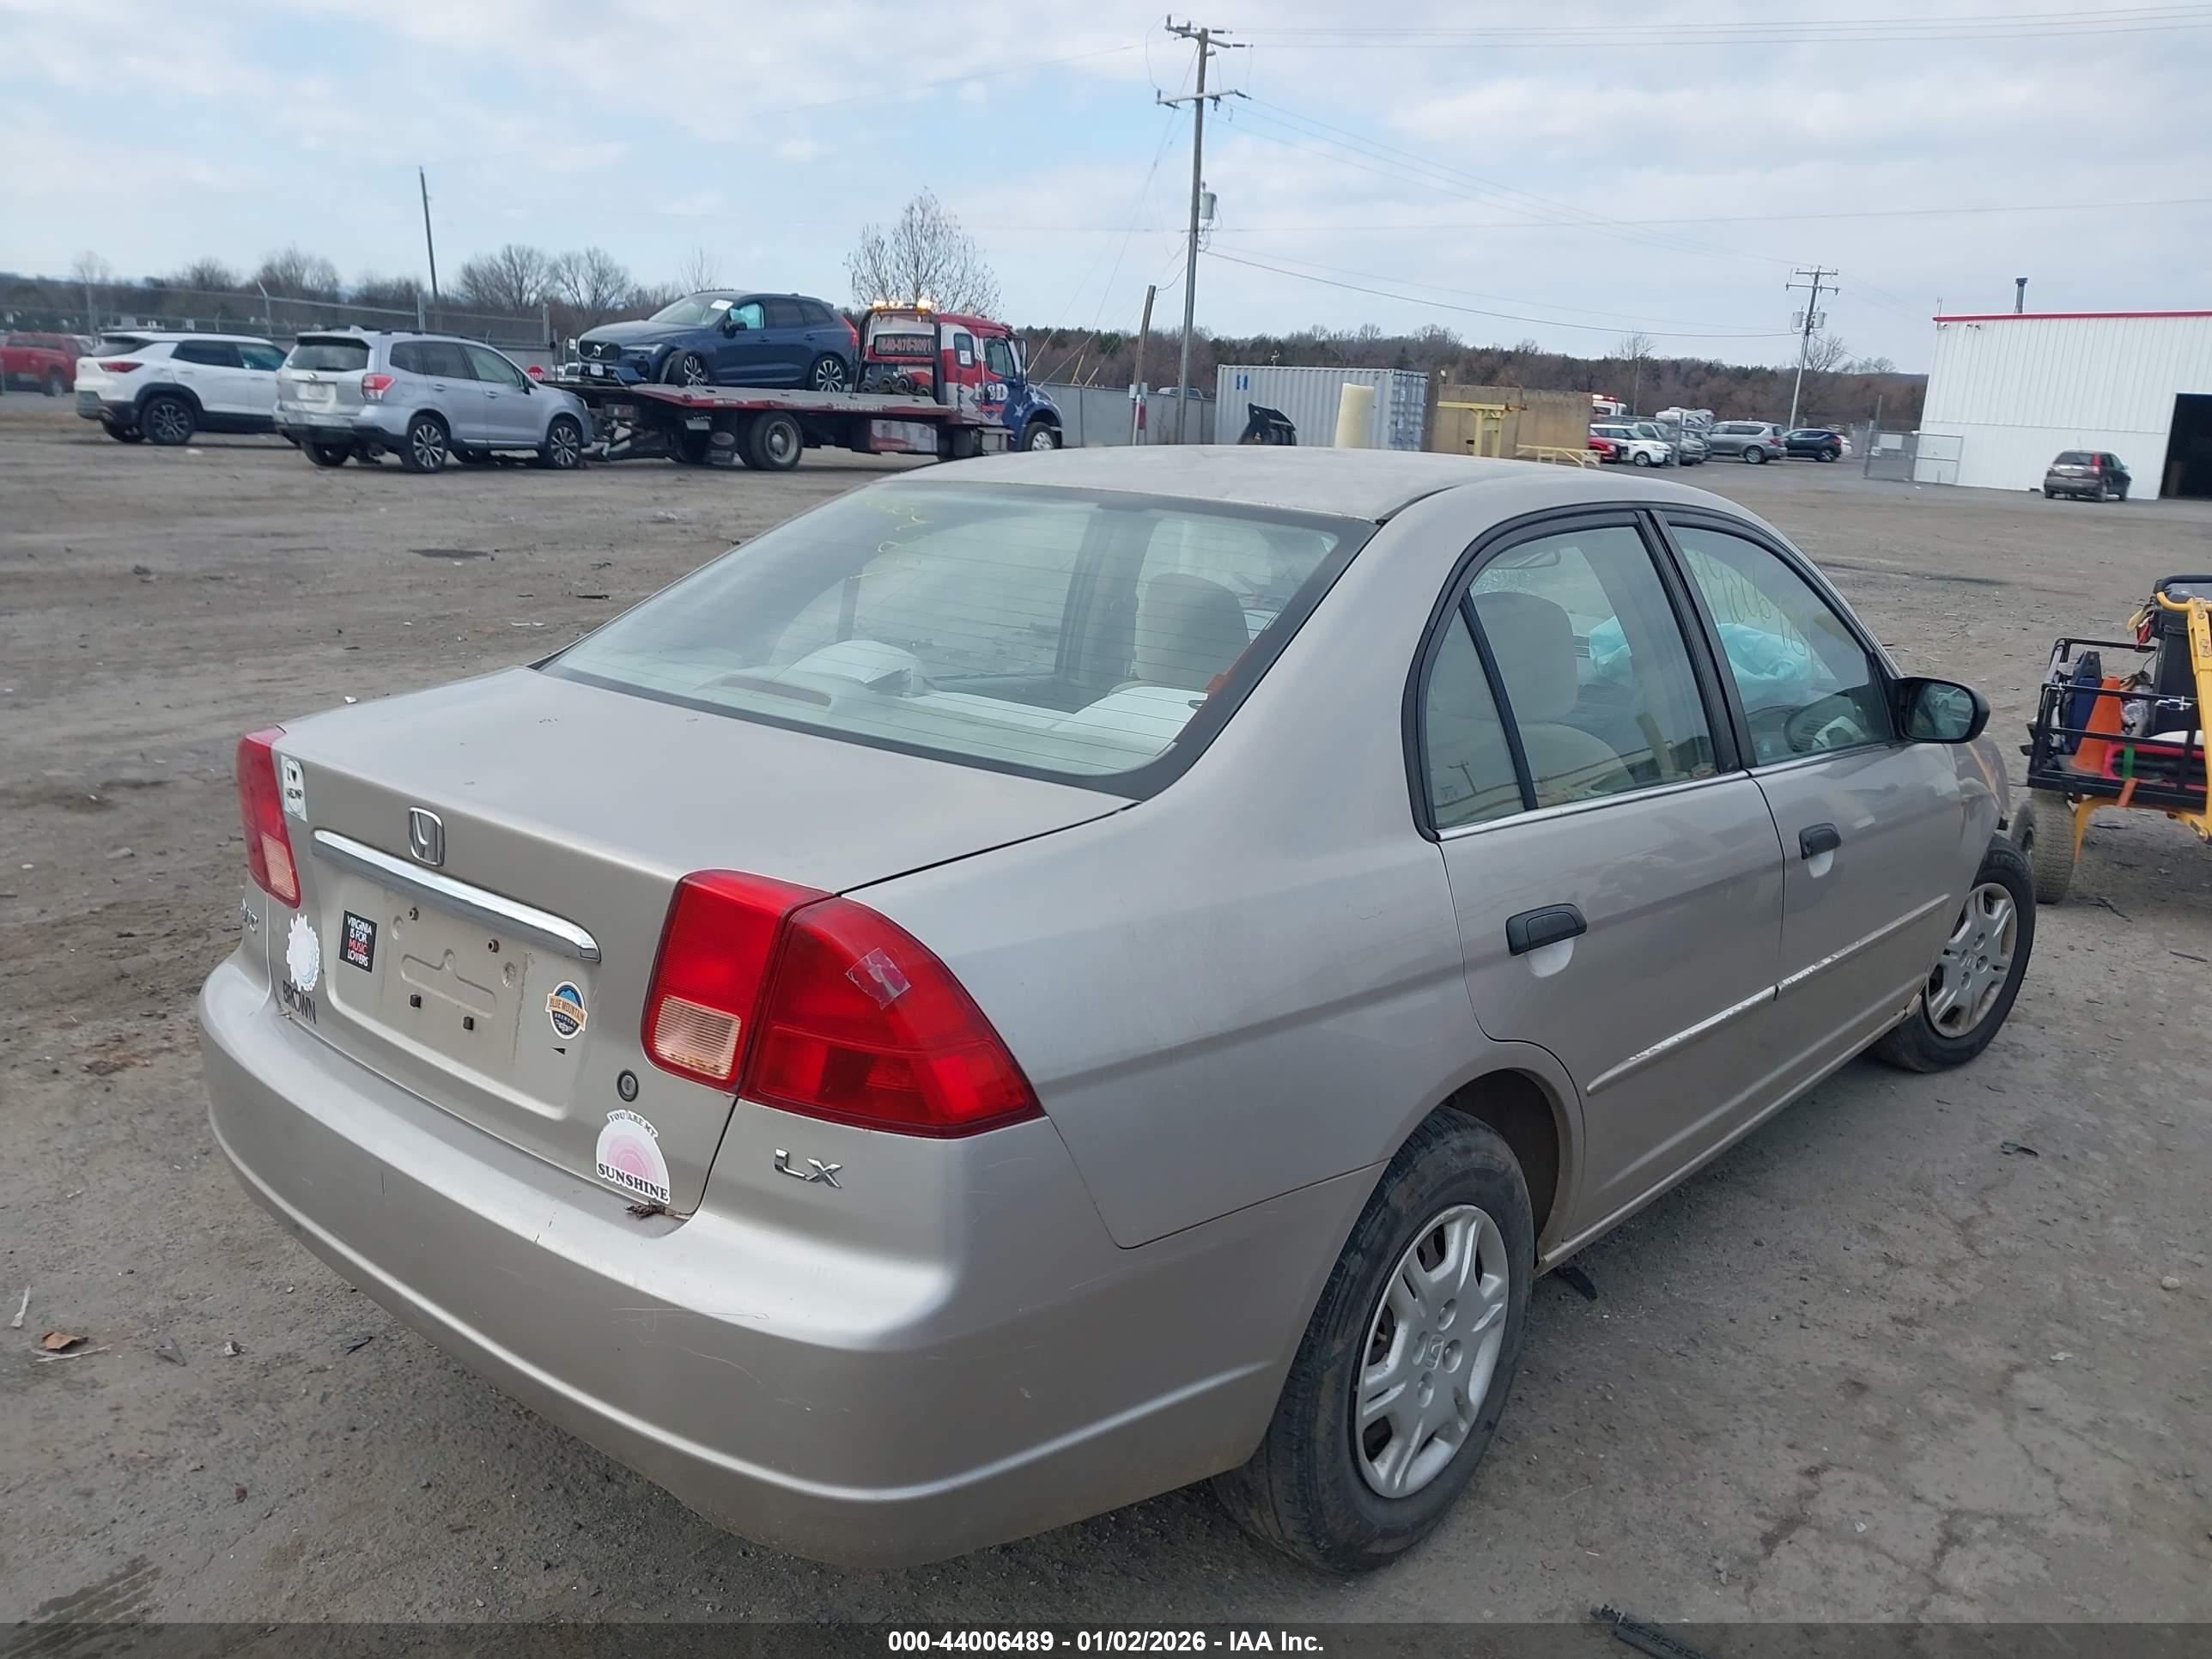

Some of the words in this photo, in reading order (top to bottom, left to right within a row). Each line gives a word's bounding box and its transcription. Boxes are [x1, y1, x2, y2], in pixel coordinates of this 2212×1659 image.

[348, 915, 373, 936] VIRGINIA
[349, 927, 355, 938] IS
[356, 930, 368, 944] FOR
[347, 948, 368, 967] LOVERS
[348, 938, 368, 955] MUSIC
[283, 980, 317, 1024] BROWN
[550, 997, 561, 1008] BLUE
[562, 1000, 585, 1023] MOUNTAIN
[609, 1112, 625, 1121] YOU
[626, 1113, 645, 1126] ARE
[644, 1122, 657, 1136] MY
[775, 1148, 842, 1188] LX
[598, 1163, 669, 1201] SUNSHINE
